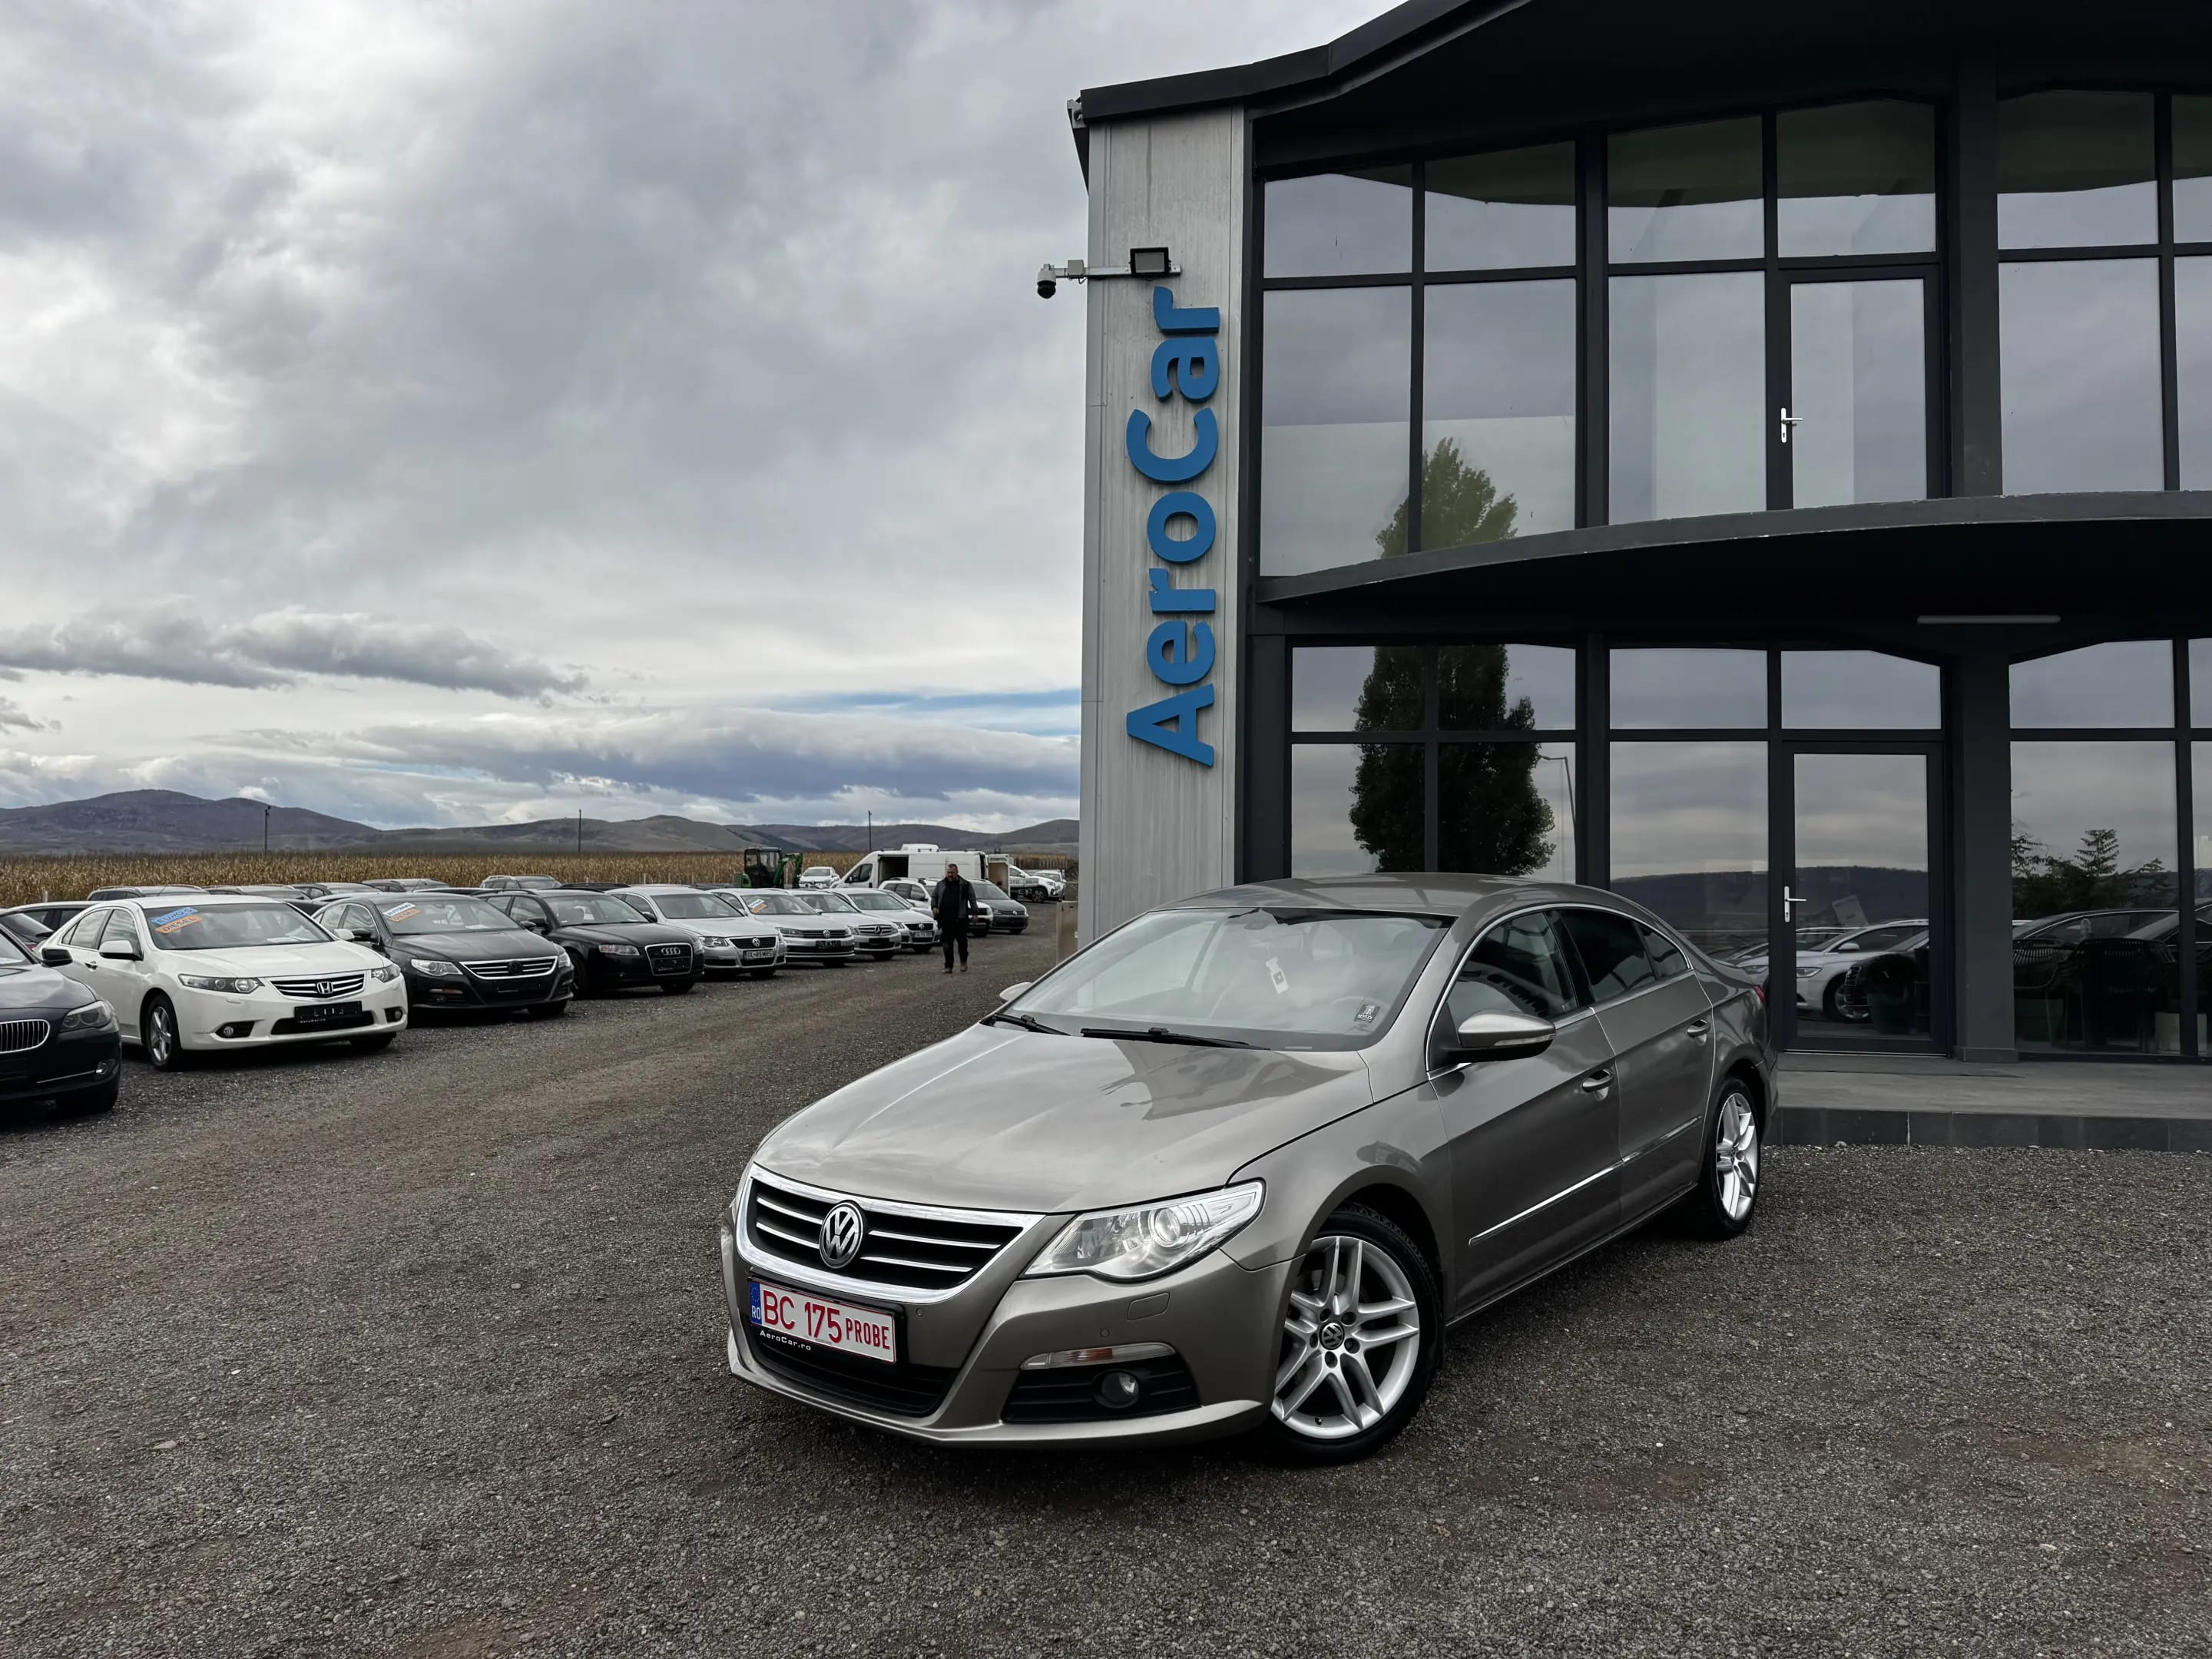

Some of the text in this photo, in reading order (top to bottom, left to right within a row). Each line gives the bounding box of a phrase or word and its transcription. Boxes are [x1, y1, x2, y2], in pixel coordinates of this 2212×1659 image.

[1126, 286, 1220, 767] AeroCar
[157, 909, 184, 922] EURO
[163, 917, 197, 931] DIESEL
[752, 1290, 891, 1350] RO BC 175 PROBE
[760, 1330, 812, 1351] AeroCar.ro
